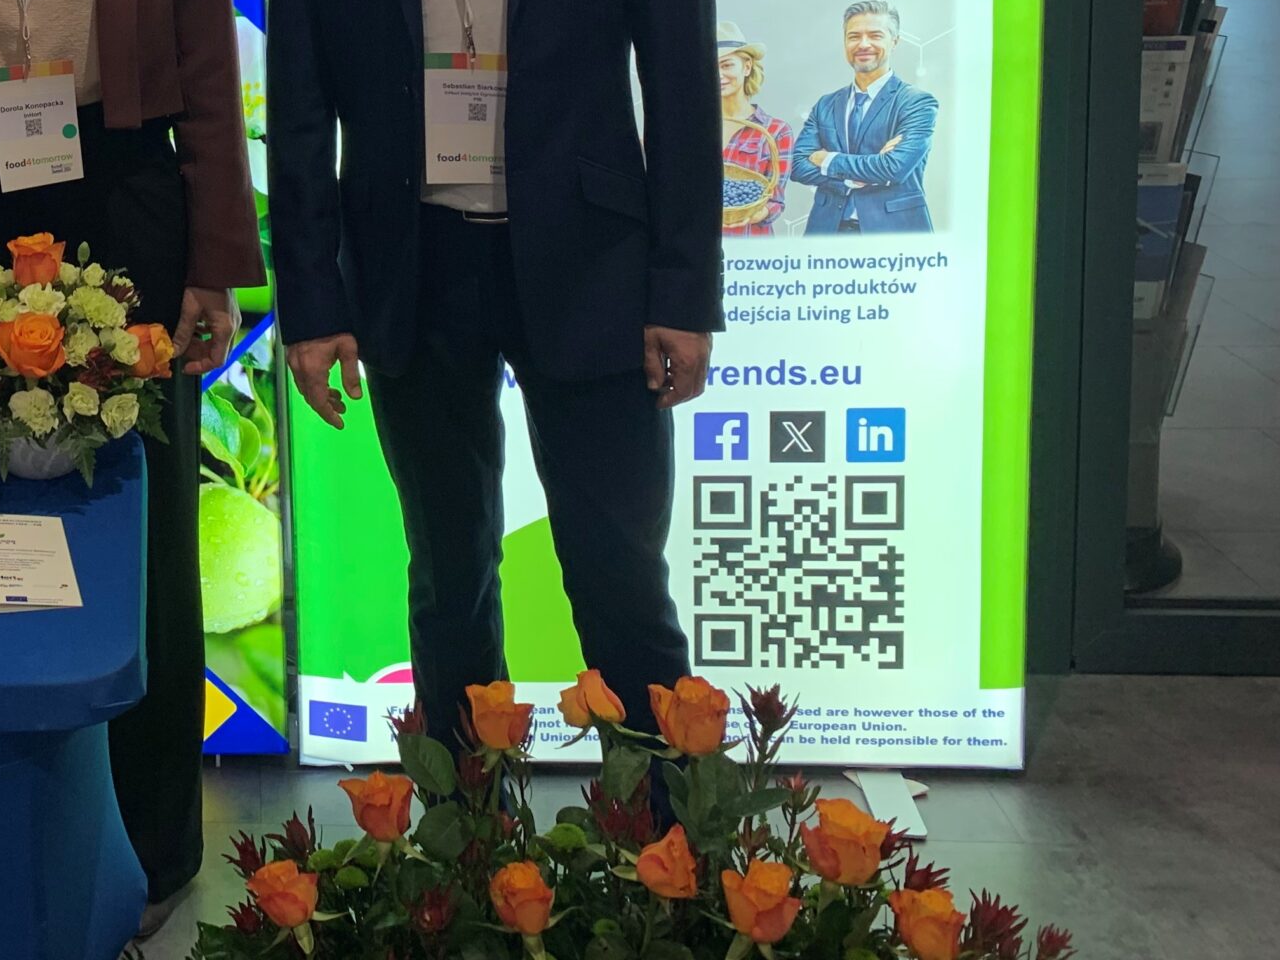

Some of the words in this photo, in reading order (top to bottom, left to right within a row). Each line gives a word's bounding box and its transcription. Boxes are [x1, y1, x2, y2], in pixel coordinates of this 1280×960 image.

[0, 105, 23, 113] Dorota
[25, 100, 64, 111] Konopacka
[5, 153, 74, 170] food4tomorrow
[727, 255, 801, 274] rozwoju
[807, 252, 949, 272] innowacyjnych
[723, 280, 806, 299] dniczych
[812, 278, 917, 298] produktów
[724, 305, 791, 324] dejścia
[797, 305, 851, 324] Living
[857, 304, 890, 321] Lab
[707, 359, 862, 386] rends.eu
[826, 709, 849, 717] are
[854, 707, 914, 718] however
[918, 707, 958, 718] those
[963, 708, 977, 718] of
[982, 708, 1005, 718] the
[790, 720, 857, 732] European
[862, 721, 908, 732] Union.
[799, 735, 816, 744] be
[821, 735, 850, 745] held
[855, 736, 938, 747] responsible
[942, 736, 962, 746] for
[967, 737, 1008, 746] them.
